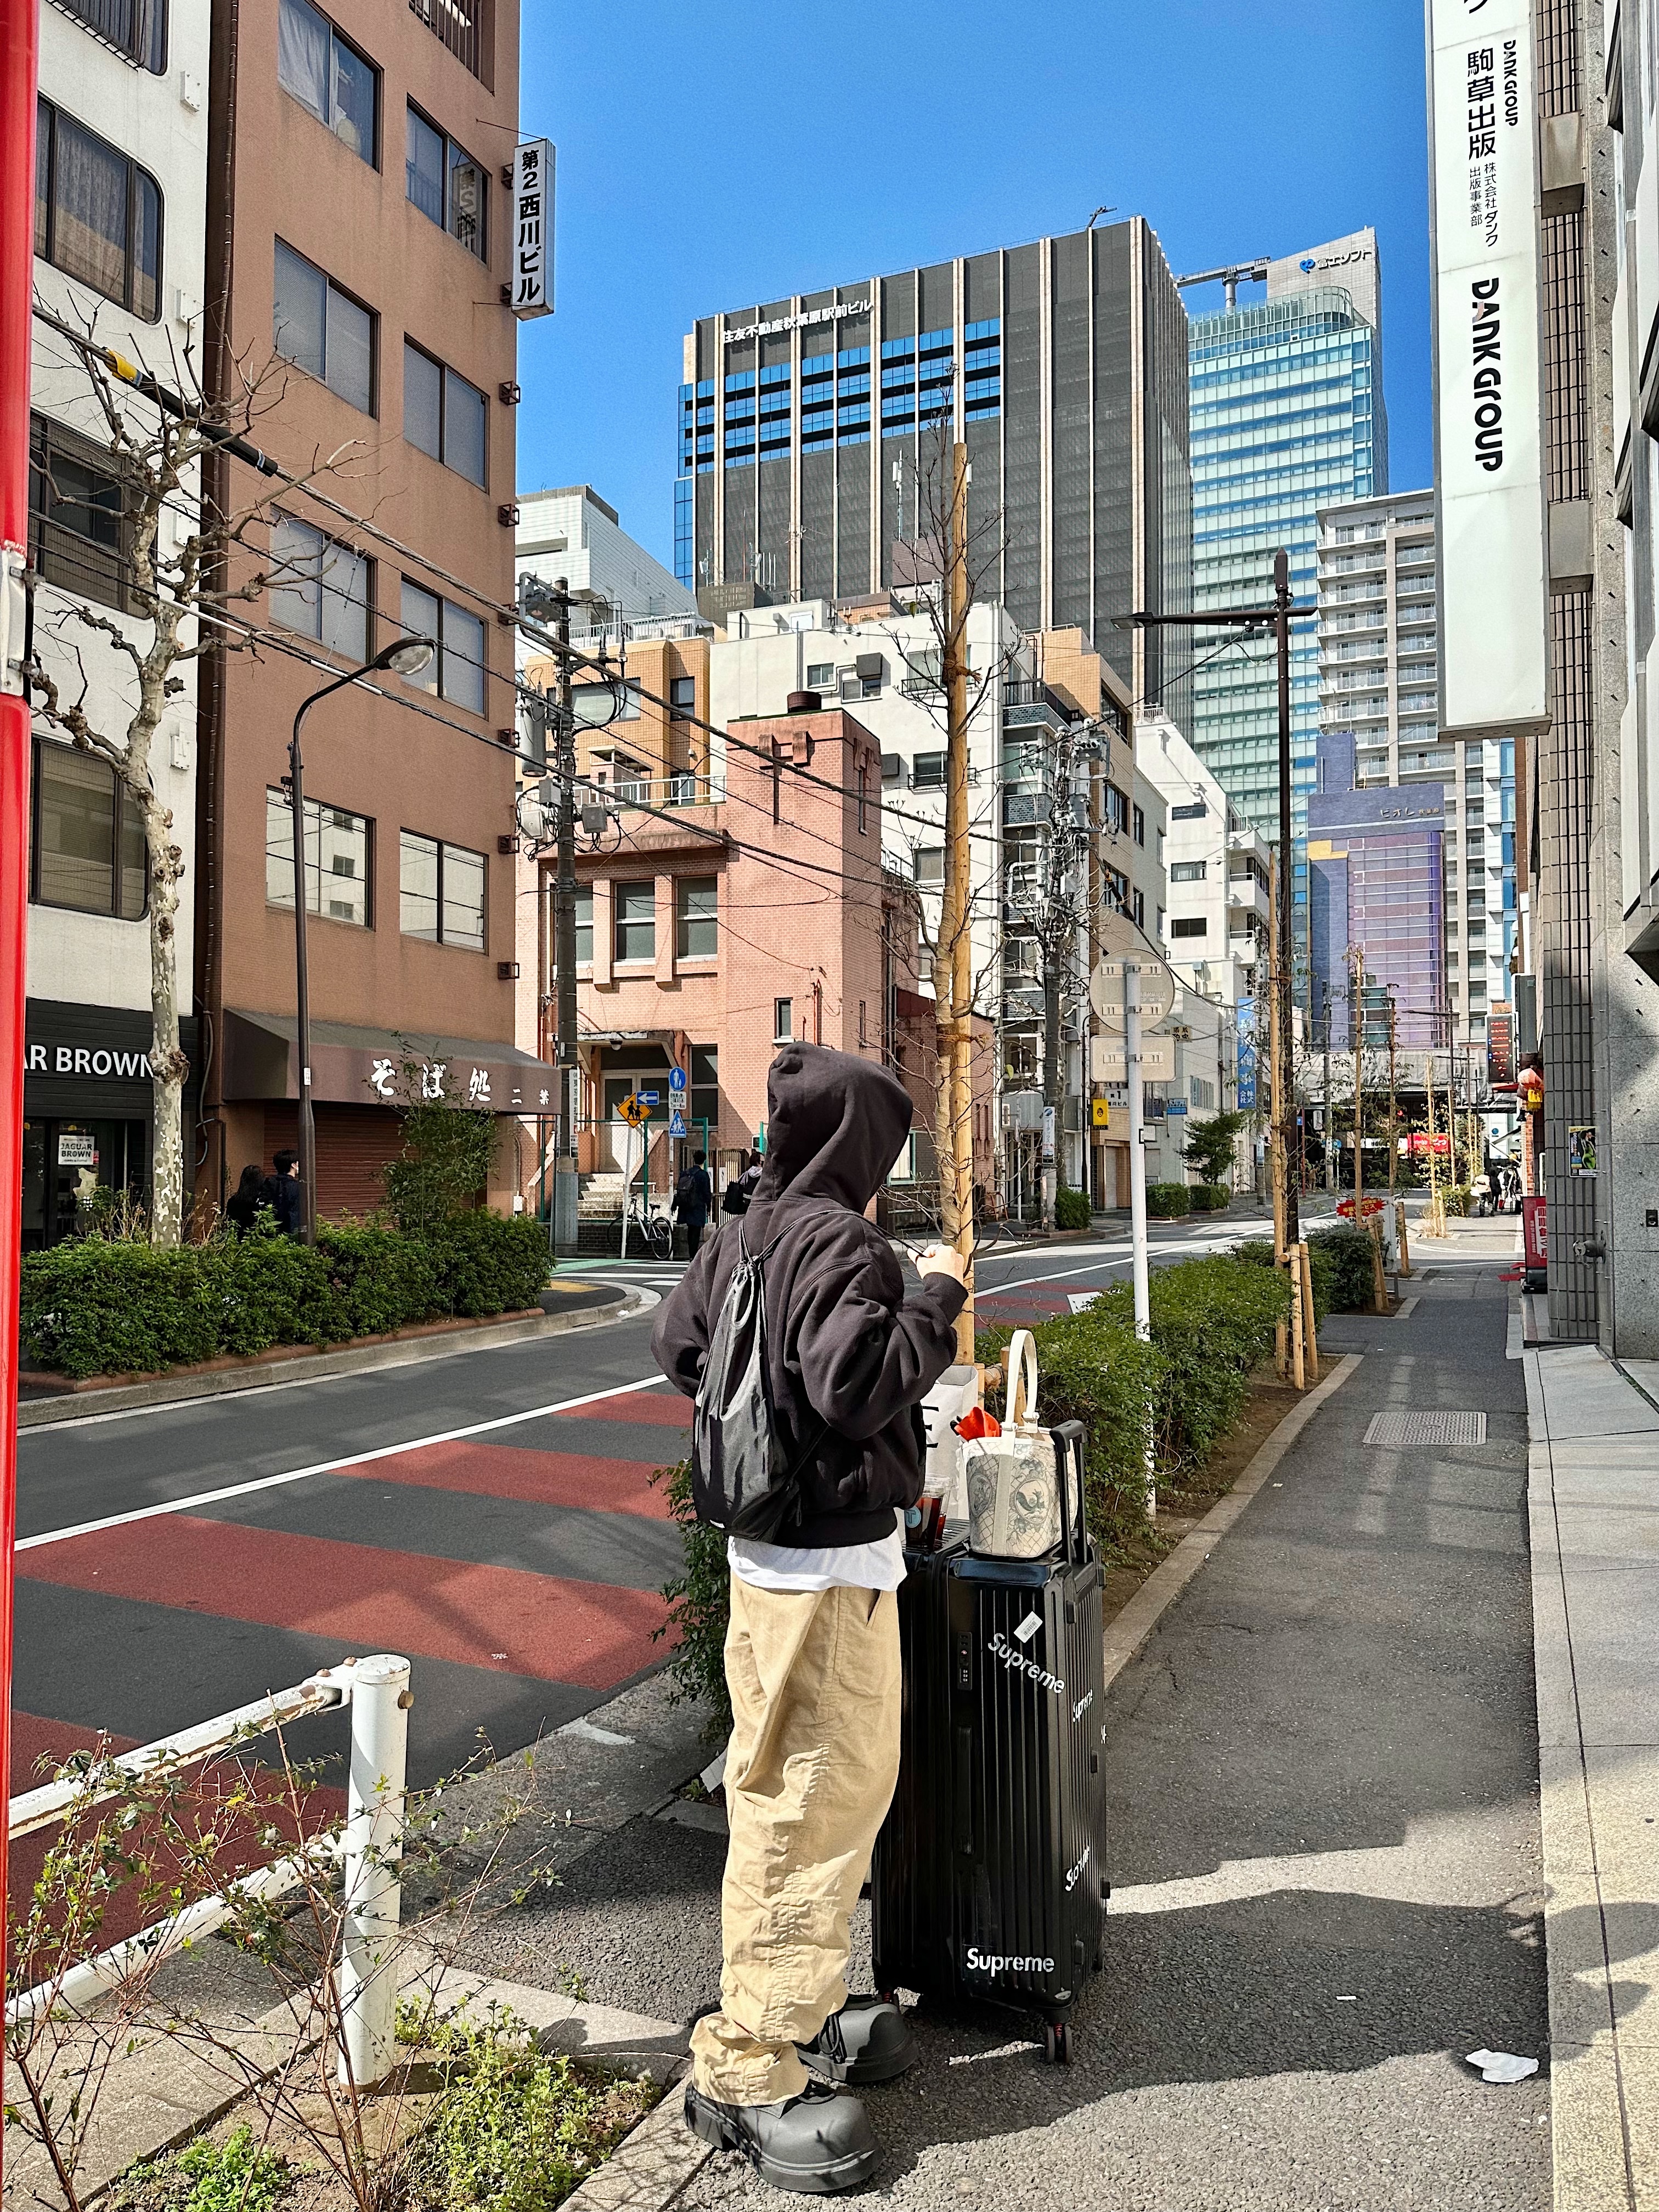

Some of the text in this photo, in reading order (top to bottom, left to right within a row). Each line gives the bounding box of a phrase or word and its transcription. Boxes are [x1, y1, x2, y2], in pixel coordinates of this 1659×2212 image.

[1467, 47, 1496, 160] 駒草出版
[1504, 80, 1518, 126] GROUP
[1470, 166, 1483, 227] 出版事業部
[1484, 162, 1498, 247] 株式会社ダンク
[517, 149, 541, 303] 第2西川ビル
[1317, 249, 1372, 270] 富士ソフト
[723, 299, 874, 344] 住友不動産秋葉原駅前ビル
[1472, 277, 1503, 471] DANK GROUP
[24, 1045, 48, 1070] R
[371, 1058, 492, 1103] そば処
[988, 1633, 1065, 1694] Supreme
[966, 1948, 1054, 1977] Supreme
